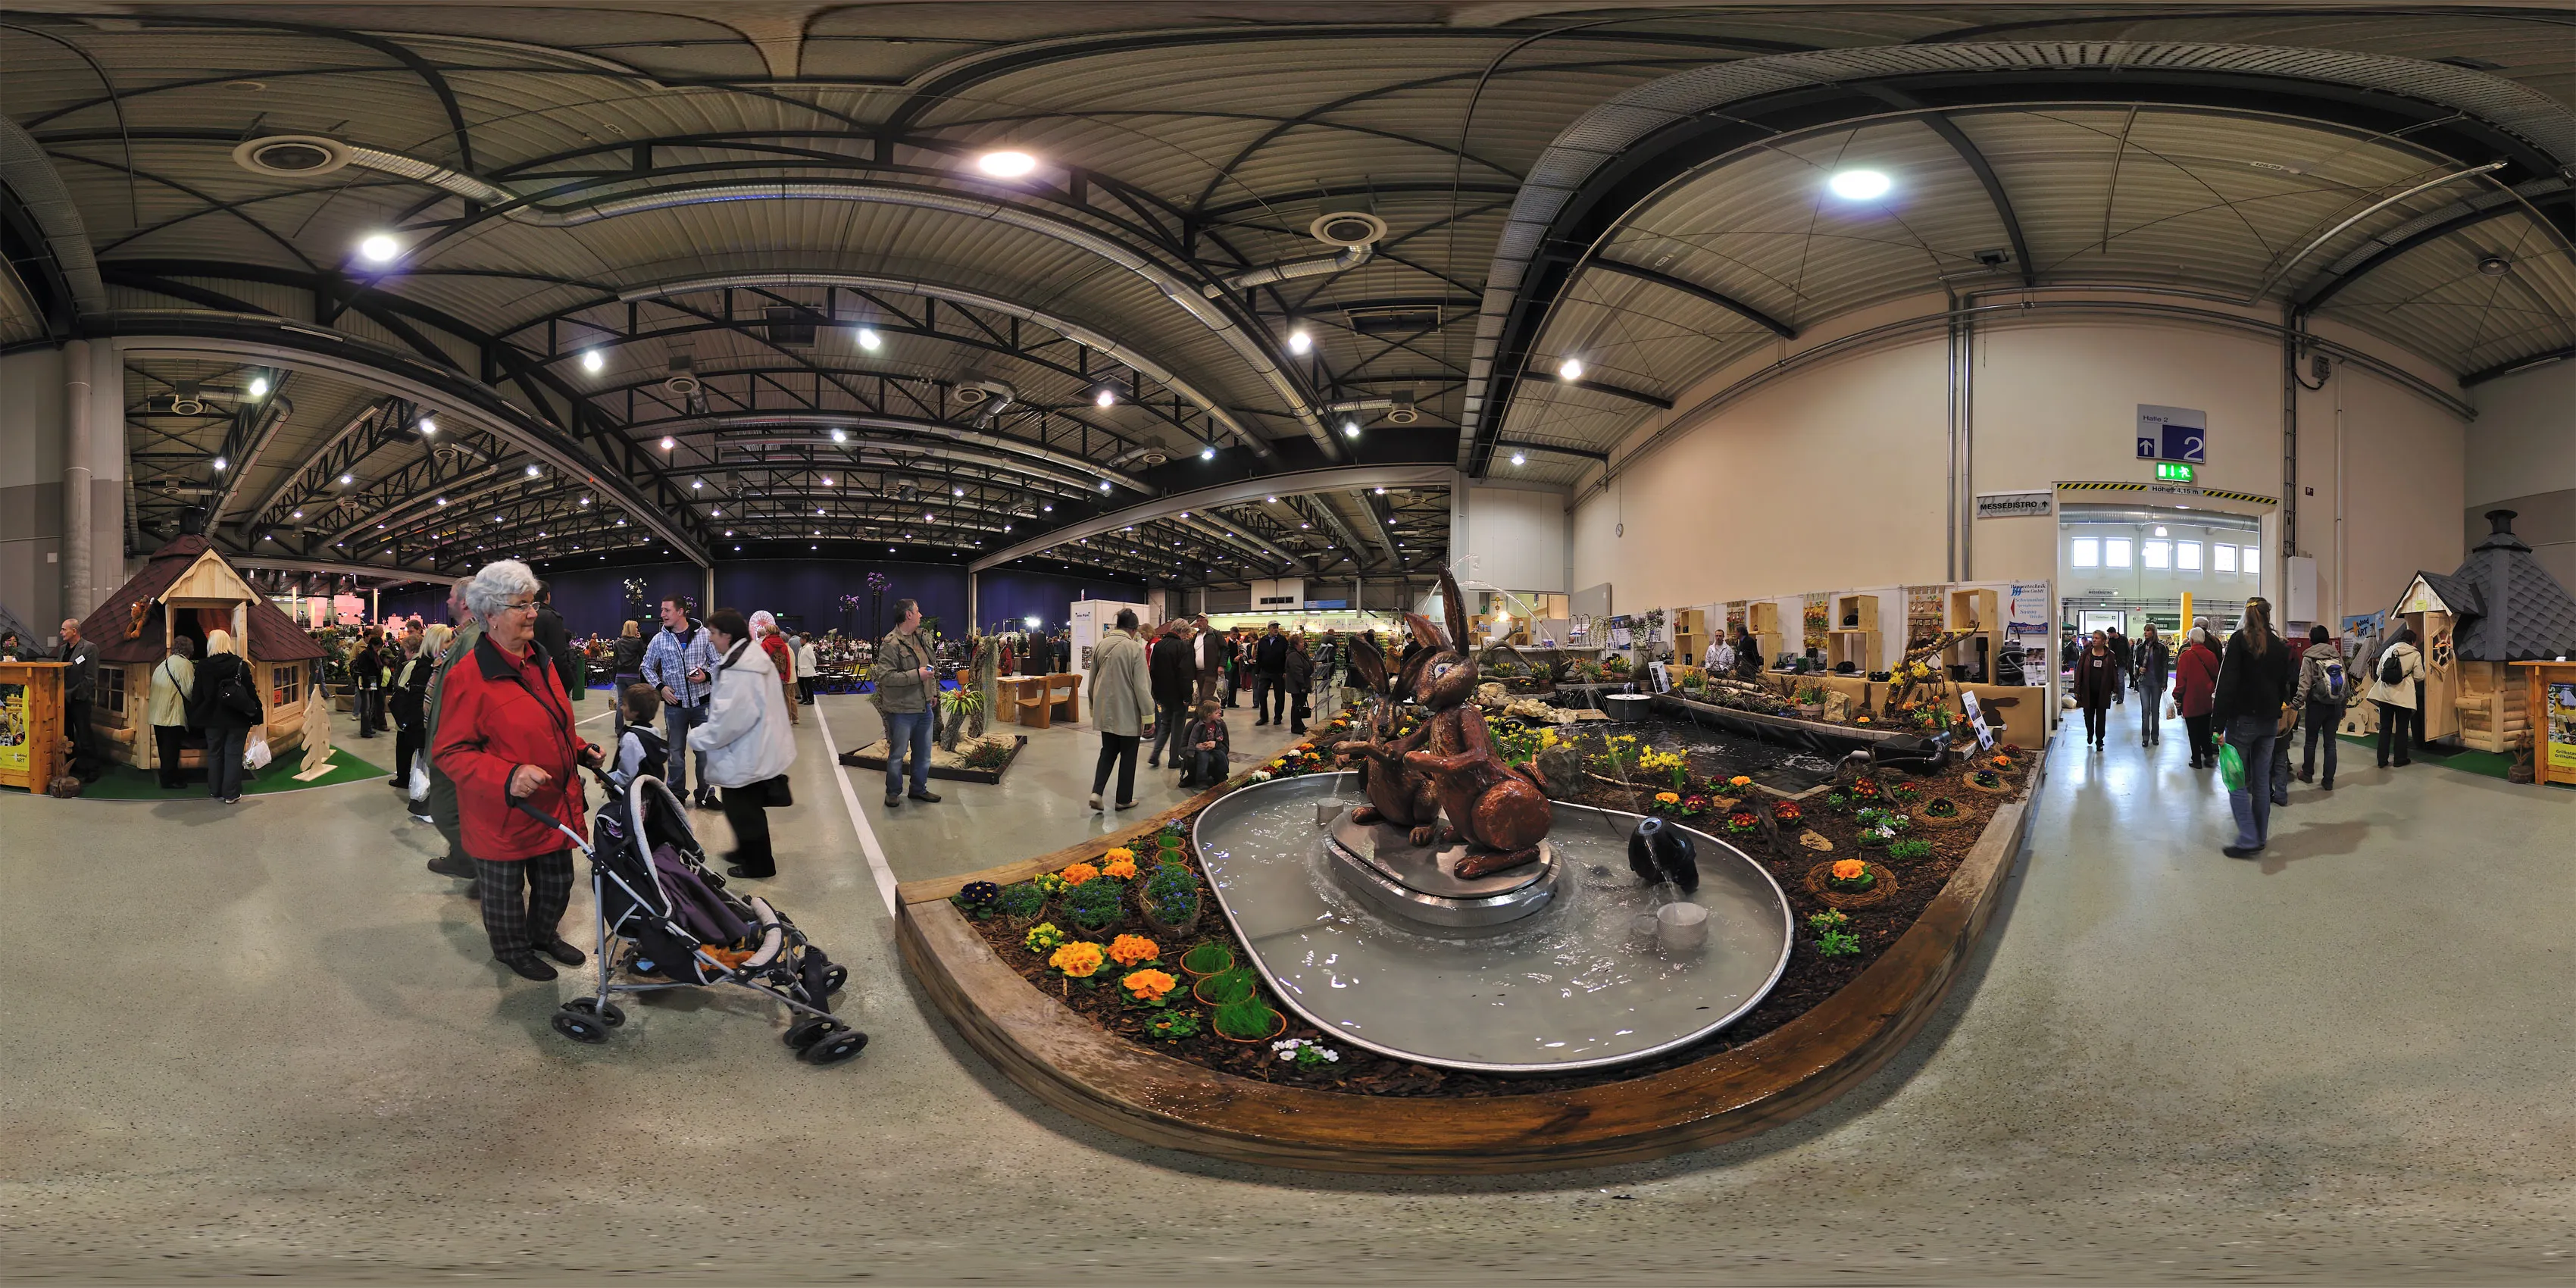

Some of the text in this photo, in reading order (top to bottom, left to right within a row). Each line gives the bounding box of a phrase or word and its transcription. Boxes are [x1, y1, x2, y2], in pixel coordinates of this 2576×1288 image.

[2184, 436, 2203, 462] 2
[1980, 501, 2037, 510] MESSEBISTRO
[2357, 627, 2368, 638] ART
